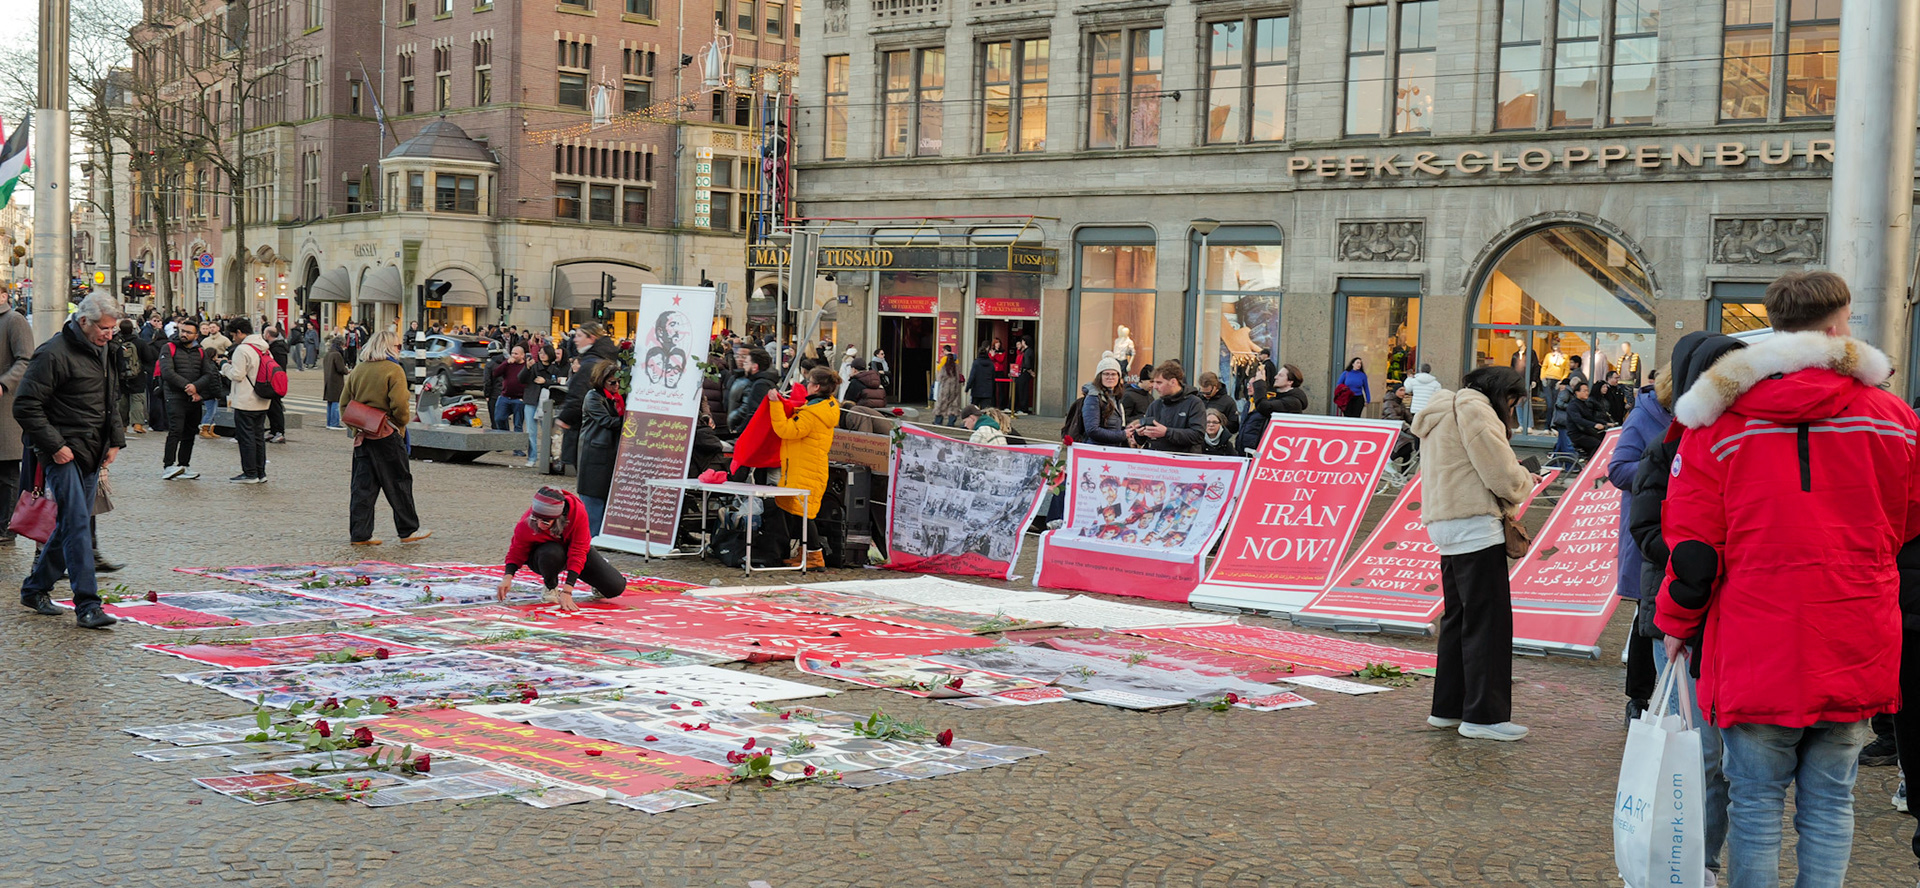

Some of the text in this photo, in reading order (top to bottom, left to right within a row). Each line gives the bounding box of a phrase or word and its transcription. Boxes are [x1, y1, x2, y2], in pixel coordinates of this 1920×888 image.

[1287, 139, 1834, 177] PEEK & CLOPPENBUR
[825, 249, 893, 266] TUSSAUD
[1266, 436, 1377, 465] STOP
[1255, 467, 1369, 485] EXECUTION
[1291, 488, 1316, 501] IN
[1257, 503, 1346, 527] IRAN
[1571, 501, 1620, 515] PRISO
[1572, 515, 1620, 528] MUST
[1556, 529, 1619, 542] RELEAS
[1237, 536, 1336, 562] NOW!
[1563, 543, 1608, 554] NOW
[1362, 556, 1441, 570] EXECUTI
[1538, 559, 1613, 573] کارگر زندانی
[1368, 568, 1439, 581] IN IRAN
[1534, 574, 1563, 586] گردد
[1563, 575, 1583, 587] باید
[1586, 573, 1611, 587] آزاد
[1366, 579, 1411, 590] NOW
[1667, 774, 1683, 884] primark.com
